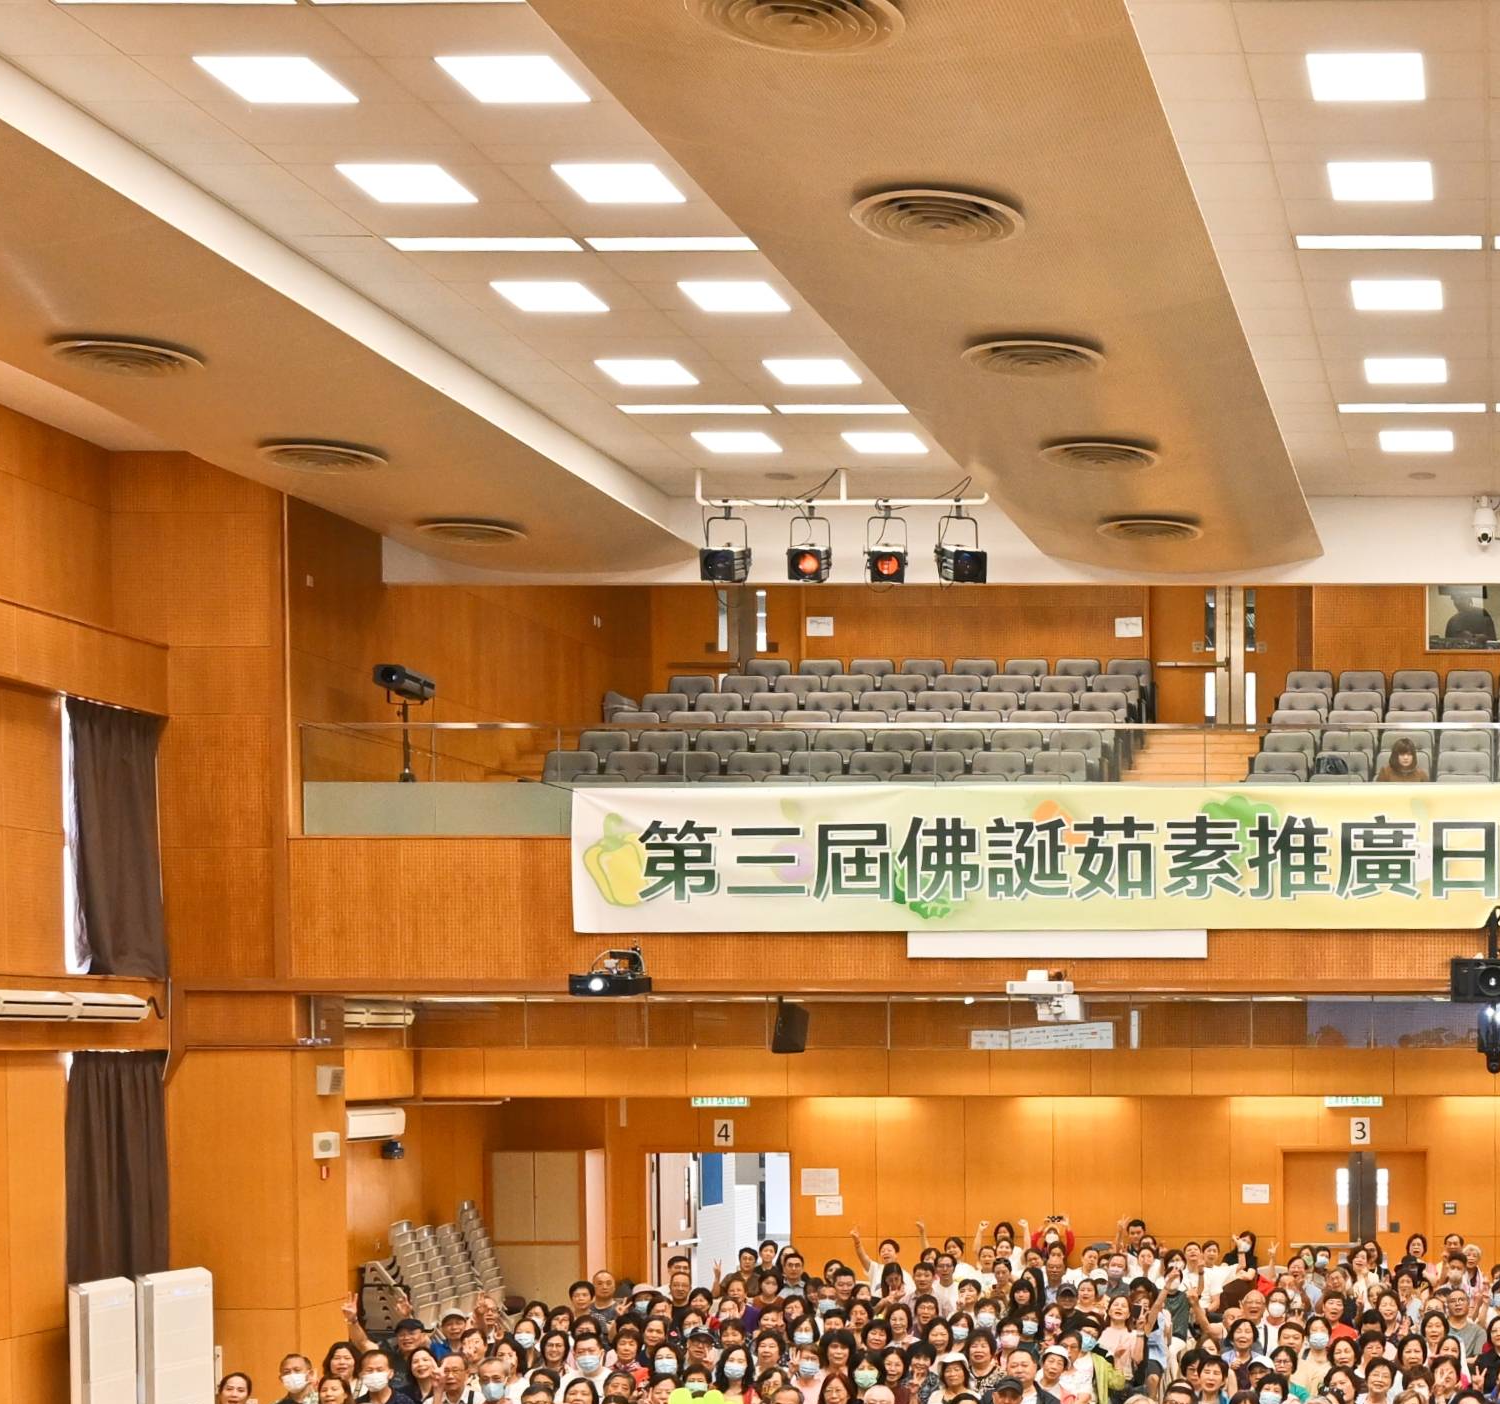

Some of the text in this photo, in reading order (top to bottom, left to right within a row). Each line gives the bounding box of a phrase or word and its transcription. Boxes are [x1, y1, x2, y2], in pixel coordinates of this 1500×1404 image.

[637, 815, 1499, 903] 第三屆佛誕茹素推廣日
[716, 1123, 731, 1142] 4
[1354, 1121, 1367, 1140] 3
